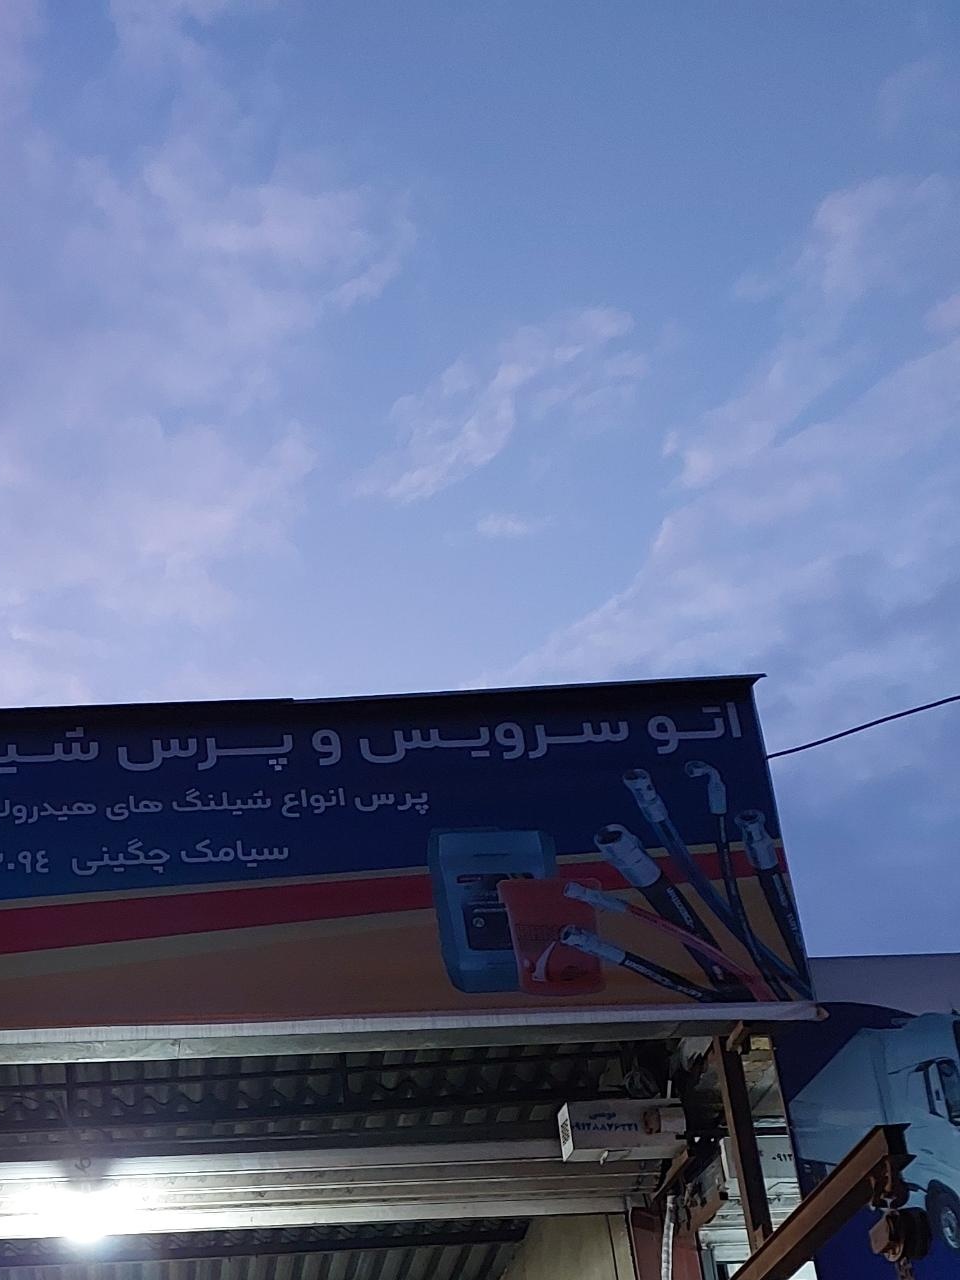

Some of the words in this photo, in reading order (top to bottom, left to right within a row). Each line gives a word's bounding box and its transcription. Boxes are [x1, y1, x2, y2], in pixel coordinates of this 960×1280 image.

[359, 718, 630, 764] سرویس
[646, 701, 742, 754] اتو
[117, 733, 293, 772] پرس
[310, 727, 341, 766] و
[105, 795, 163, 822] های
[171, 787, 272, 815] شیلنگ
[280, 787, 346, 818] انواع
[353, 791, 429, 815] پرس
[71, 838, 170, 876] چگینی
[180, 839, 289, 868] سیامک
